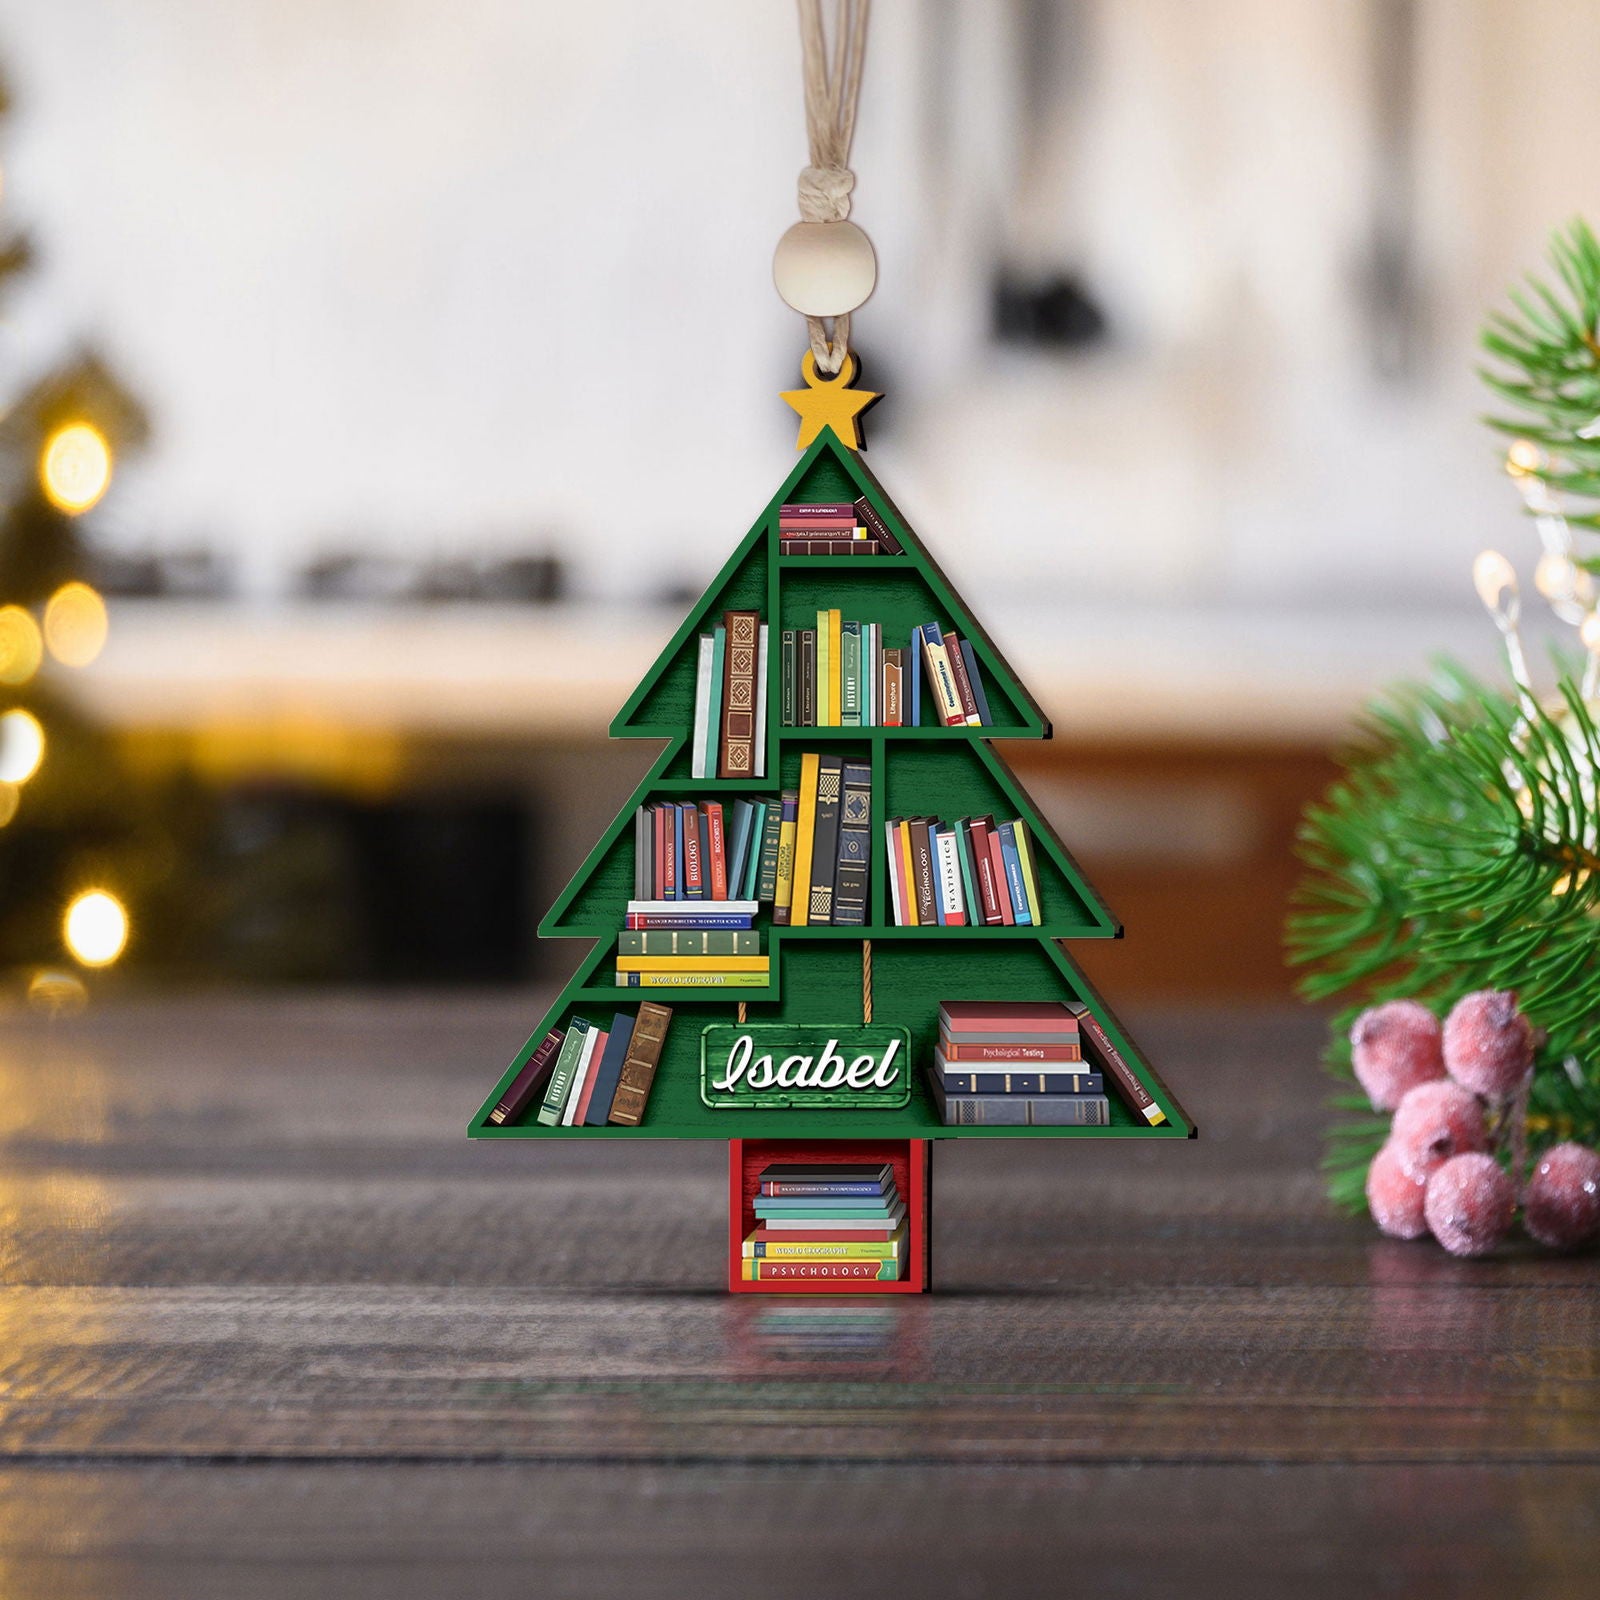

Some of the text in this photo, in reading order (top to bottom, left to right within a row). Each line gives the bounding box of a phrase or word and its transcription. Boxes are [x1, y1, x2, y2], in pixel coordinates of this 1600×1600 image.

[847, 676, 856, 707] HISTORY
[689, 838, 698, 881] BIOLOGY
[919, 846, 931, 906] TECHNOLOGY
[944, 839, 956, 910] STATISTICS
[712, 1035, 901, 1092] Isabel
[983, 1048, 1044, 1059] Psychological Testing
[550, 1070, 567, 1102] HISTORY
[771, 1266, 871, 1276] PSYCHOLOGY
